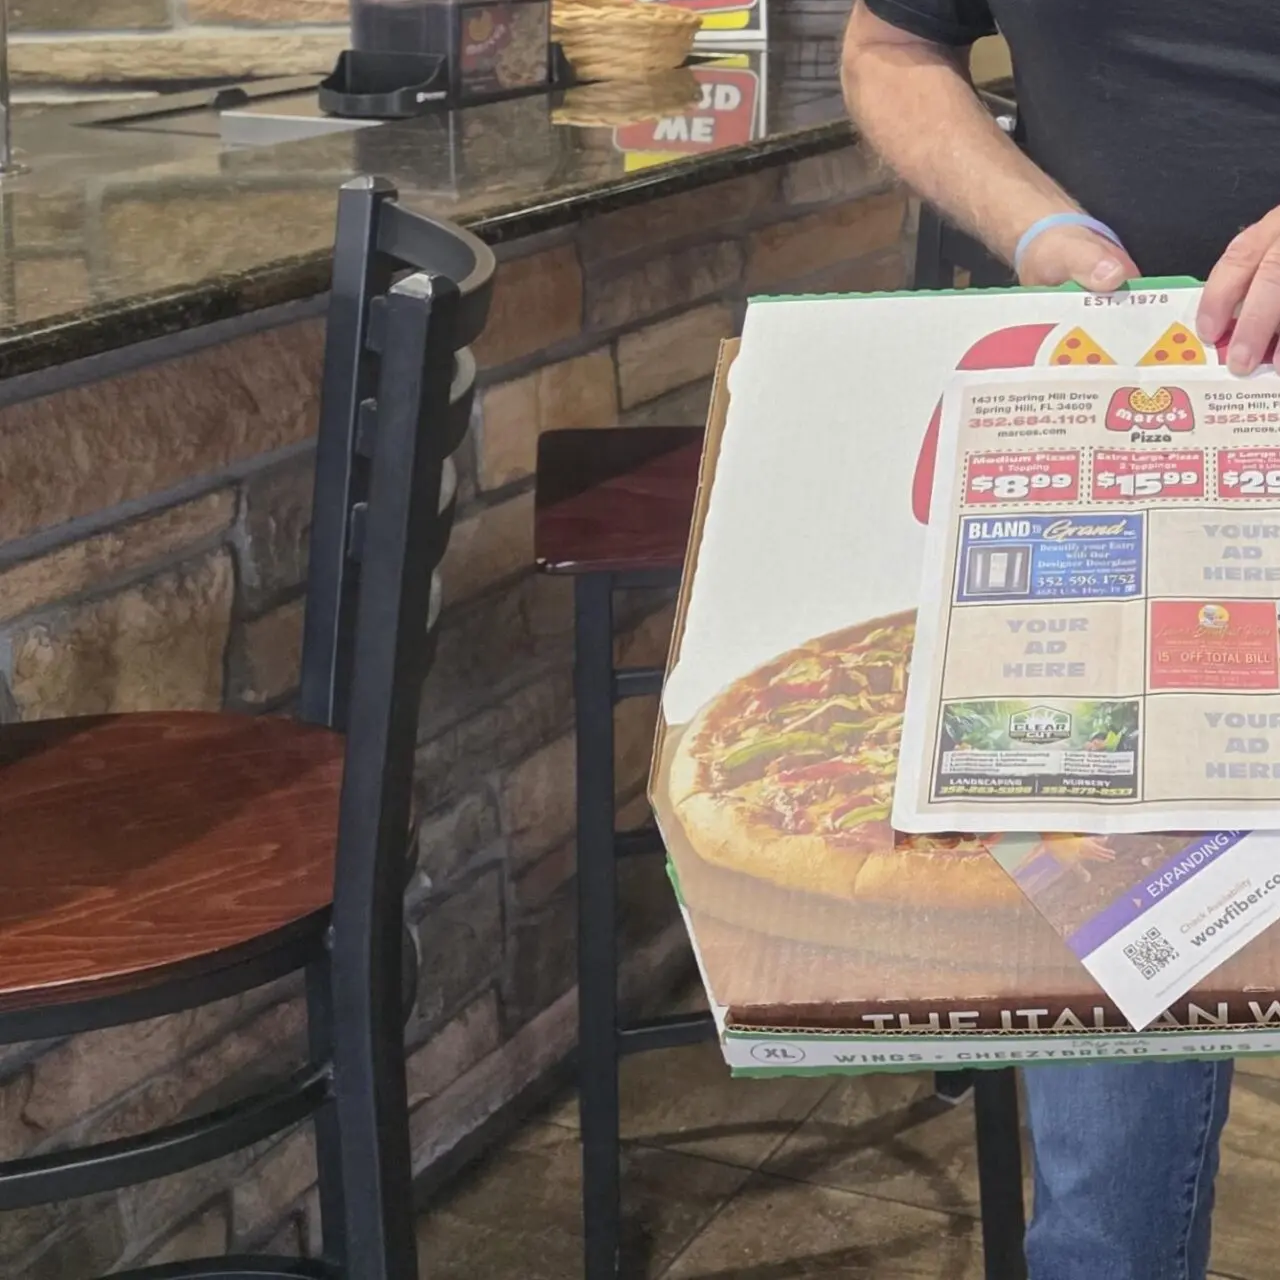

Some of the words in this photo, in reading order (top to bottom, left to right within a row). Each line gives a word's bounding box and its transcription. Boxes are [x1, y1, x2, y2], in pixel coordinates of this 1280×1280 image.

[1083, 296, 1120, 307] EST.
[1129, 294, 1169, 306] 1978
[1008, 393, 1045, 403] Spring
[1048, 392, 1066, 401] Hill
[1069, 392, 1099, 401] Drive
[975, 405, 1011, 415] Spring
[1015, 403, 1037, 413] Hill,
[1040, 403, 1054, 411] FL
[1208, 403, 1244, 412] Spring
[1247, 402, 1270, 410] Hill,
[998, 428, 1067, 438] marcos.com
[1130, 431, 1172, 443] Pizza
[973, 455, 1032, 464] Medium
[1008, 464, 1050, 472] Topping
[968, 520, 1031, 540] BLAND
[1042, 519, 1127, 542] Grand
[1202, 524, 1280, 539] YOUR
[1222, 546, 1263, 560] AD
[1103, 573, 1135, 585] 1752
[1006, 618, 1089, 633] YOUR
[1024, 640, 1068, 654] AD
[1180, 652, 1203, 662] OFF
[1206, 652, 1240, 663] TOTAL
[1245, 653, 1271, 664] BILL
[1003, 662, 1085, 678] HERE
[1225, 738, 1270, 753] AD
[949, 778, 1023, 786] LANDSCAPING
[1062, 779, 1112, 788] NURSERY
[1146, 832, 1229, 898] EXPANDING
[1179, 911, 1206, 935] Check
[1205, 876, 1252, 914] Availability
[861, 1010, 979, 1030] THE
[763, 1048, 796, 1059] XL
[833, 1053, 923, 1063] WINGS
[957, 1047, 1148, 1060] CHEEZYBREAD
[1182, 1043, 1252, 1052] SUBS
